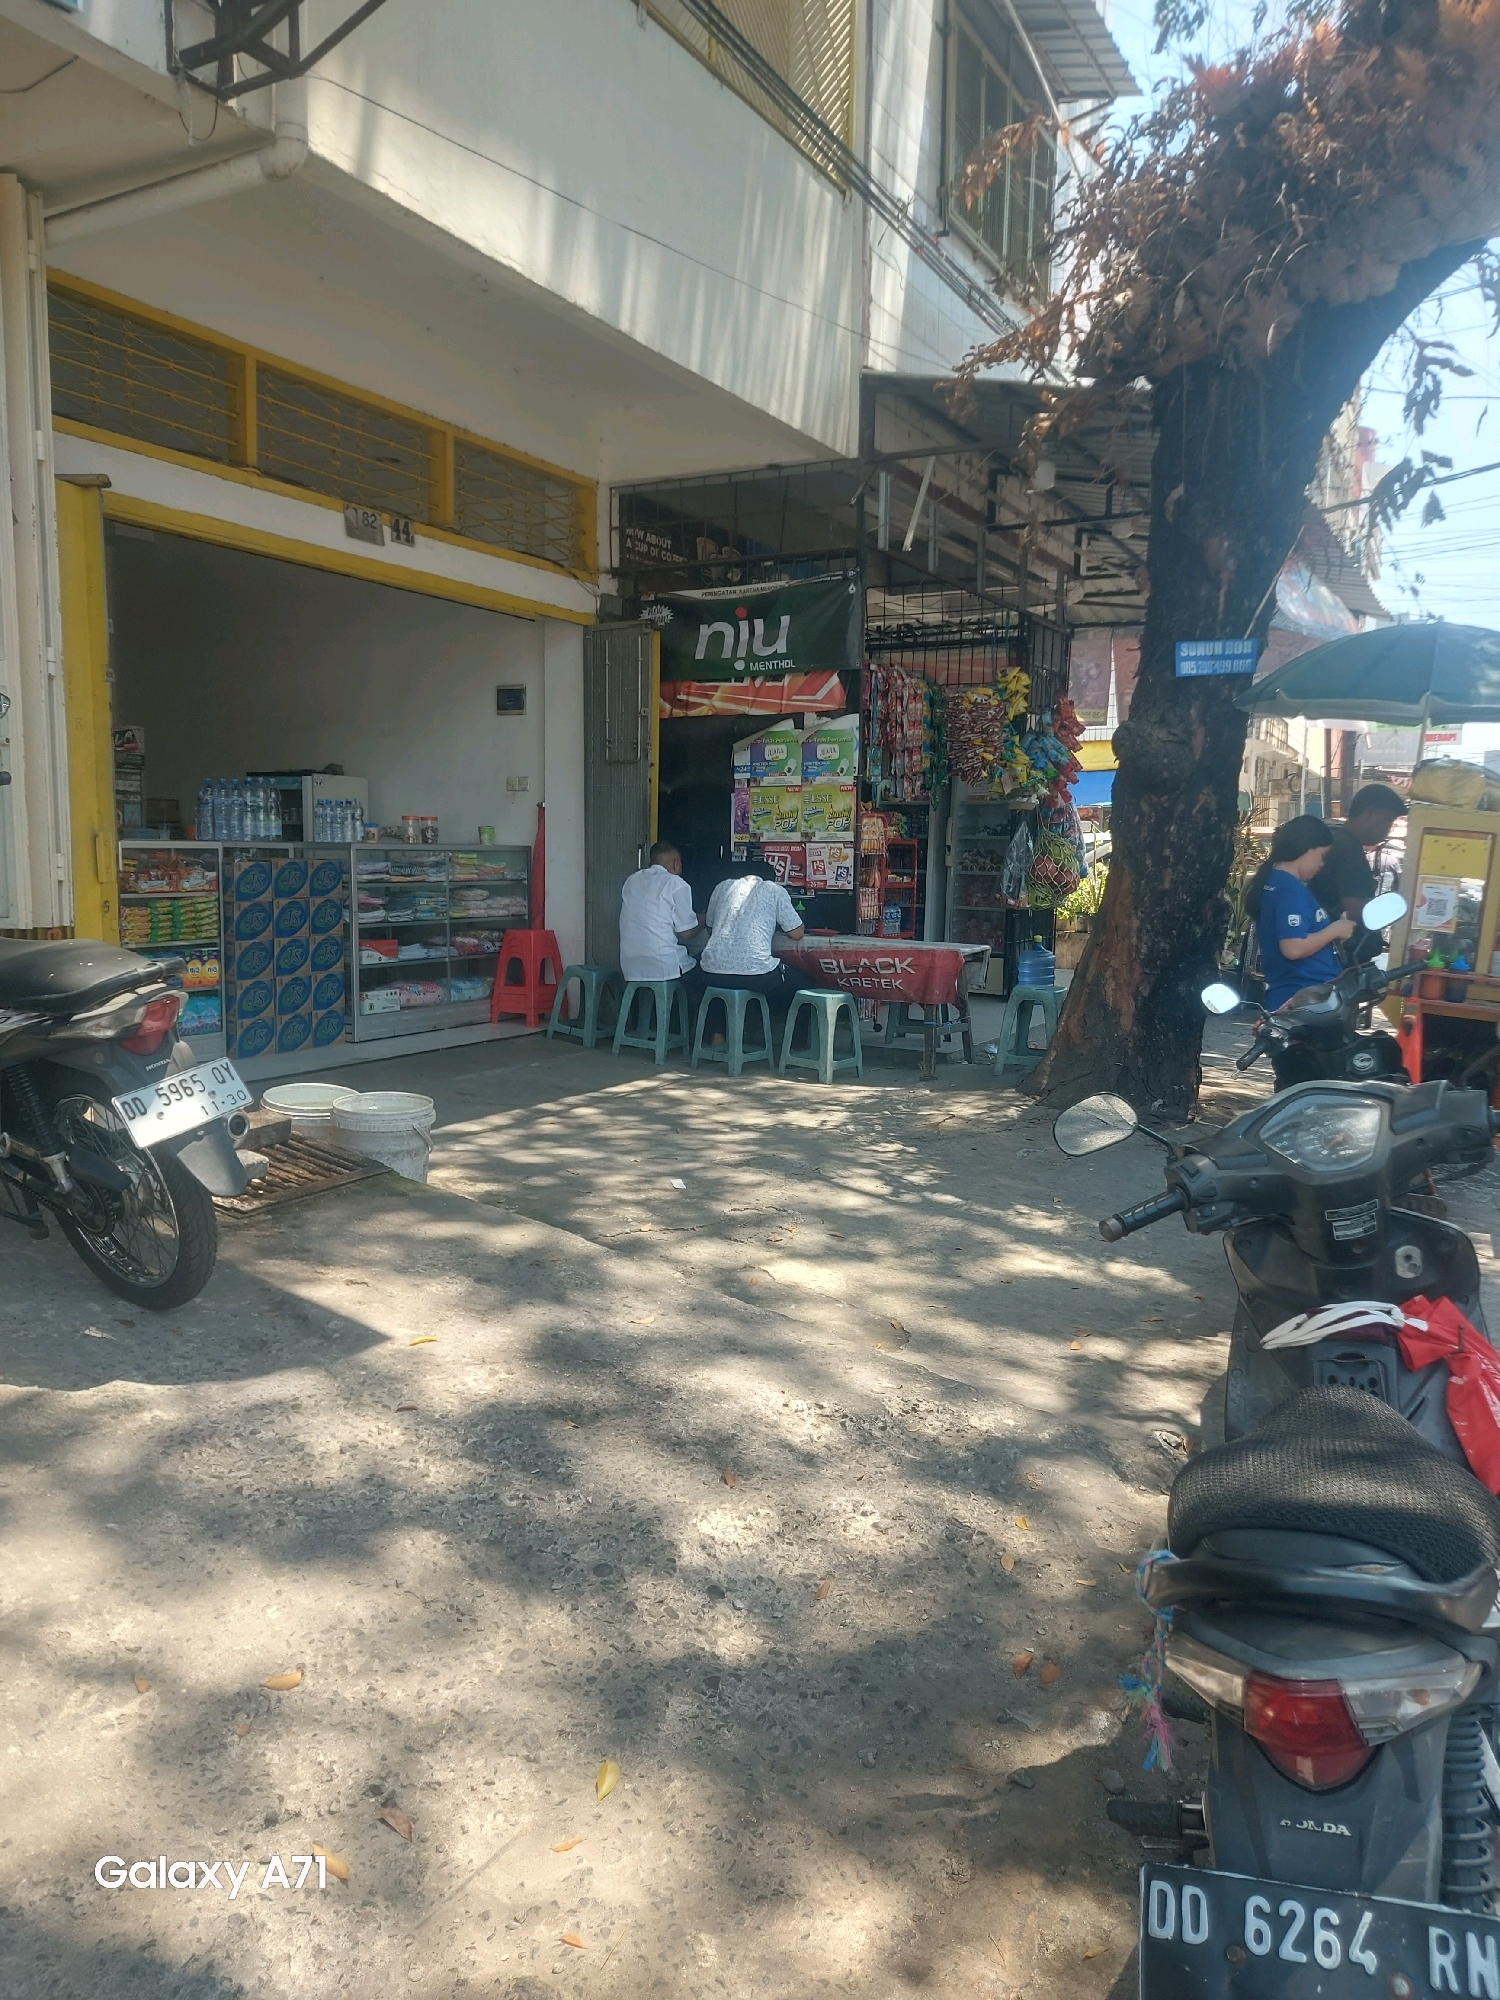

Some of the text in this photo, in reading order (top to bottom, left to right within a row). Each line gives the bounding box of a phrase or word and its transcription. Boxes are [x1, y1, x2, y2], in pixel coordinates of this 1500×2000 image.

[625, 538, 632, 549] A
[646, 532, 672, 550] ABOUT
[749, 659, 796, 671] MENTHOL
[819, 957, 916, 974] BLACK
[837, 977, 904, 990] KRETEK
[145, 1058, 171, 1071] HONDA
[121, 1096, 148, 1121] DD
[155, 1073, 206, 1106] 5965
[1148, 1880, 1210, 1945] DD
[1244, 1895, 1378, 1976] 6264
